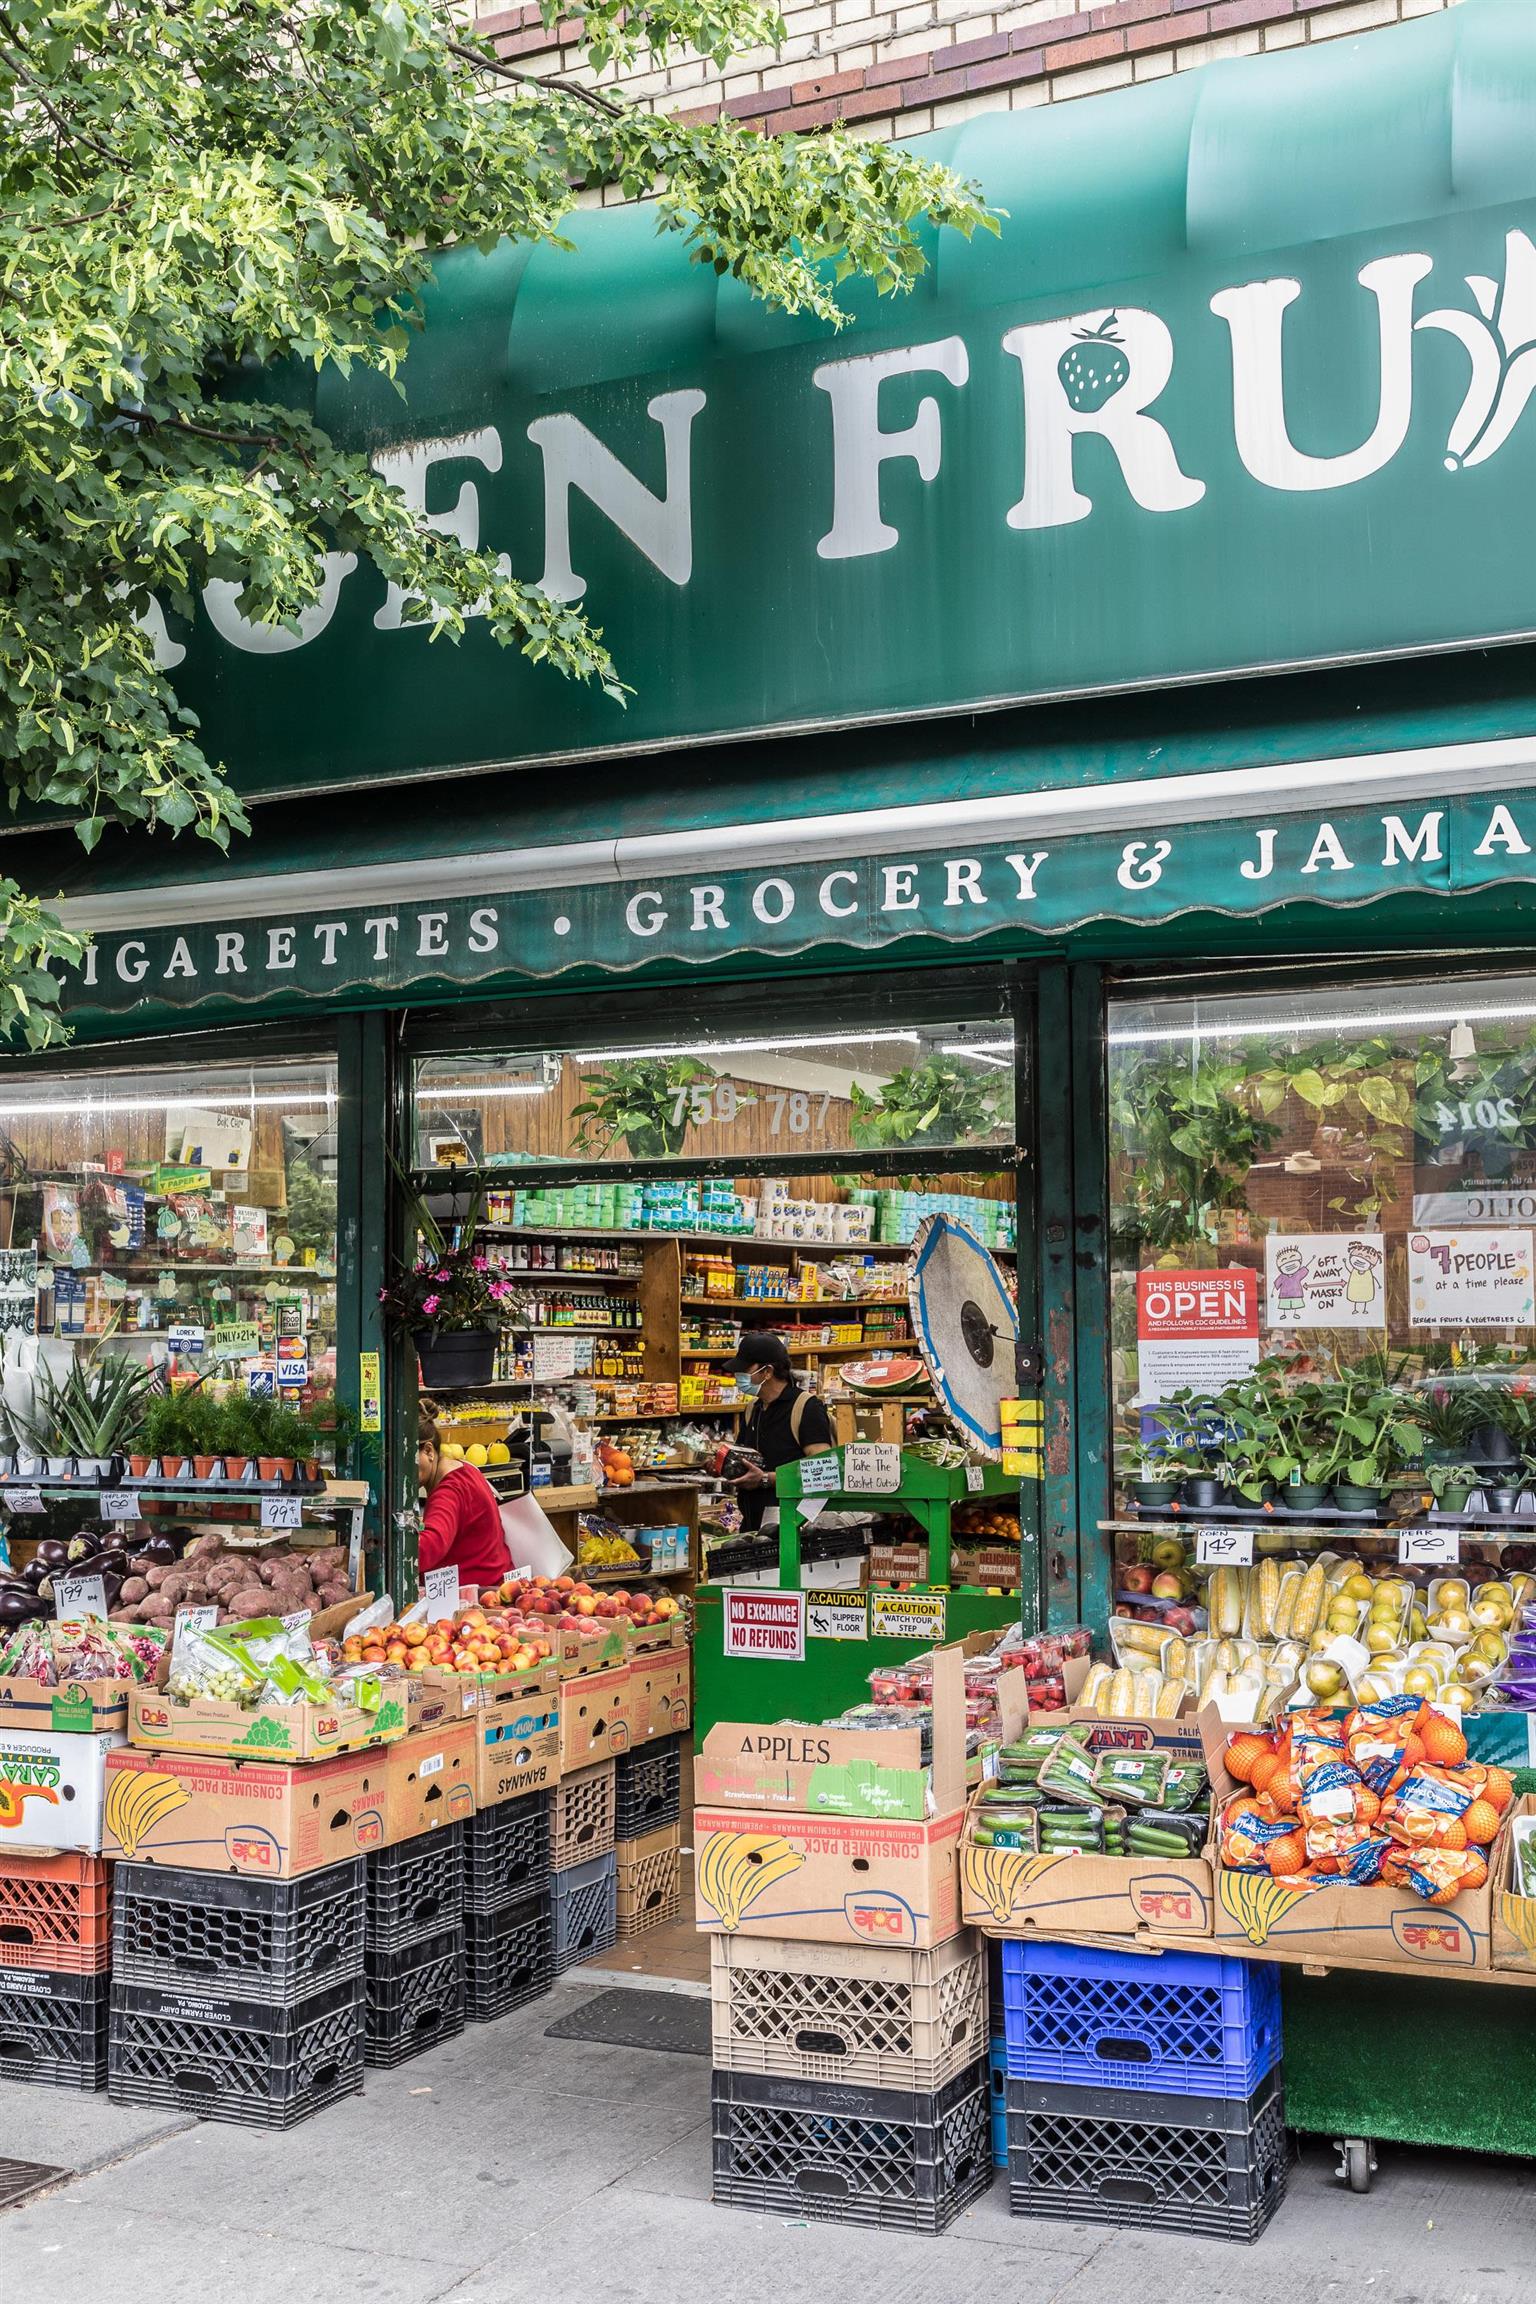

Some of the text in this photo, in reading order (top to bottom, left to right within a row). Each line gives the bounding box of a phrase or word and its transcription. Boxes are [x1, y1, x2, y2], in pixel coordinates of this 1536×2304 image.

[625, 851, 1050, 937] GROCERY
[1115, 839, 1172, 891] &
[168, 1176, 195, 1188] PAPER
[1317, 1255, 1338, 1268] 6FT
[1430, 1244, 1452, 1275] 7
[1453, 1253, 1516, 1275] PEOPLE
[1312, 1267, 1343, 1280] AWAY
[1147, 1280, 1245, 1292] THIS BUSINESS IS
[1435, 1277, 1524, 1291] at a time please
[1310, 1288, 1343, 1300] MASKS
[1145, 1290, 1246, 1319] OPEN
[1318, 1299, 1334, 1310] ON
[1162, 1319, 1195, 1327] FOLLOWS
[1208, 1318, 1247, 1326] GUIDELINES
[1412, 1316, 1437, 1325] BERGEN
[1440, 1316, 1463, 1324] FRUITS
[1471, 1316, 1515, 1324] VEGETABLES
[176, 1328, 196, 1337] LOREX
[216, 1331, 237, 1344] ONLY
[281, 1364, 306, 1376] VISA
[845, 1443, 893, 1456] Please Don't
[852, 1458, 891, 1472] Take The
[847, 1475, 873, 1488] Basket
[871, 1546, 894, 1559] FRESH
[871, 1558, 894, 1570] TASTY
[69, 1576, 101, 1585] SEEDLESS
[818, 1592, 865, 1608] CAUTION
[731, 1601, 798, 1624] NO EXCHANGE
[889, 1603, 937, 1616] CAUTION
[831, 1612, 865, 1623] SLIPPERY
[884, 1614, 933, 1624] WATCH YOUR
[836, 1623, 861, 1633] FLOOR
[899, 1624, 918, 1632] STEP
[731, 1627, 797, 1650] NO REFUNDS
[141, 1707, 168, 1724] Dole
[318, 1718, 339, 1733] Dole
[13, 1744, 52, 1754] PRODUCER
[740, 1736, 831, 1765] APPLES
[195, 1765, 222, 1775] PREMIUM
[258, 1772, 286, 1783] PREMIUM
[498, 1765, 547, 1795] BANANAS
[190, 1777, 283, 1800] CONSUMER PACK
[351, 1790, 385, 1813] BANANAS
[723, 1790, 766, 1801] Strawberries
[697, 1818, 764, 1832] PREMIUM BANANAS
[771, 1822, 842, 1836] PREMIUM BANANAS
[356, 1823, 379, 1843] Dole
[849, 1827, 921, 1840] PREMIUM BANANAS
[232, 1842, 271, 1865] Dole
[803, 1837, 920, 1859] CONSUMER PACK
[1139, 1895, 1192, 1920] Dole
[854, 1908, 903, 1934] Dole
[1403, 1927, 1461, 1953] Dole
[3, 1973, 11, 1981] PA
[6, 1981, 52, 1995] CLOVER FARMS
[177, 1999, 186, 2007] PA
[187, 2001, 214, 2011] READING,
[159, 2005, 231, 2022] CLOVER FARMS DAIRY
